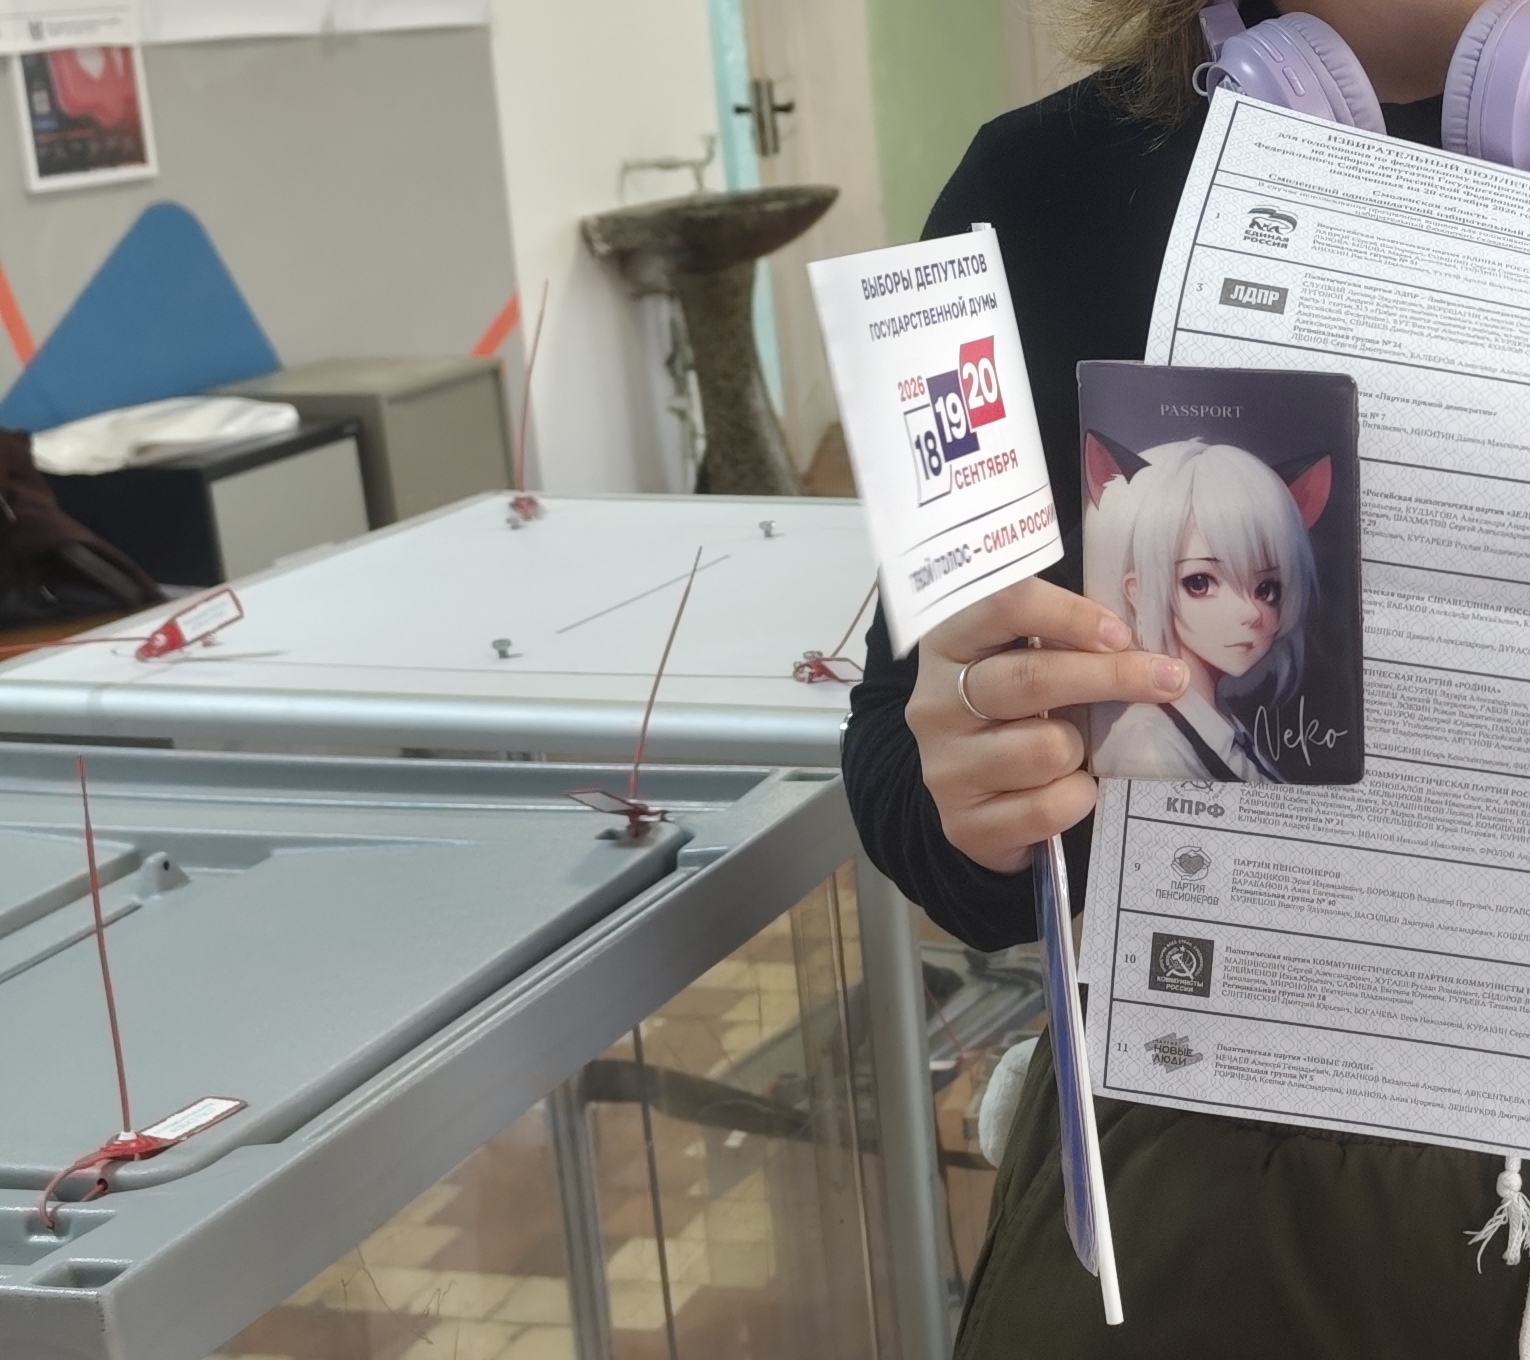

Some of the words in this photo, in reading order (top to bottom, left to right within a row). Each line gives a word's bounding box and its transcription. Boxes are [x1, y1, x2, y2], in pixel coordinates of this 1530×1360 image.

[1243, 236, 1288, 249] РОССИЯ
[1244, 230, 1289, 244] ЕДИНАЯ
[861, 269, 913, 300] ВЫБОРЫ
[916, 253, 988, 291] ДЕПУТАТОВ
[1229, 284, 1280, 307] ЛДПР
[869, 296, 967, 342] ГОСУДАРСТВЕННОЙ
[969, 292, 998, 319] ДУМЫ
[898, 375, 925, 402] 2026
[962, 357, 998, 409] 20
[935, 392, 968, 443] 19
[1160, 403, 1244, 419] PASSPORT
[913, 430, 943, 480] 18
[954, 448, 1018, 490] СЕНТЯБРЯ
[984, 523, 1019, 554] СИЛА
[1253, 695, 1348, 766] Neko
[1166, 796, 1224, 819] КПРФ
[1134, 862, 1140, 871] 9
[1155, 888, 1218, 905] ПЕНСИОНЕРОВ
[1170, 880, 1204, 893] ПАРТИЯ
[1124, 953, 1135, 964] 10
[1116, 1042, 1128, 1052] 11
[1154, 1043, 1192, 1057] НОВЫЕ
[1152, 1053, 1186, 1066] ЛЮДИ
